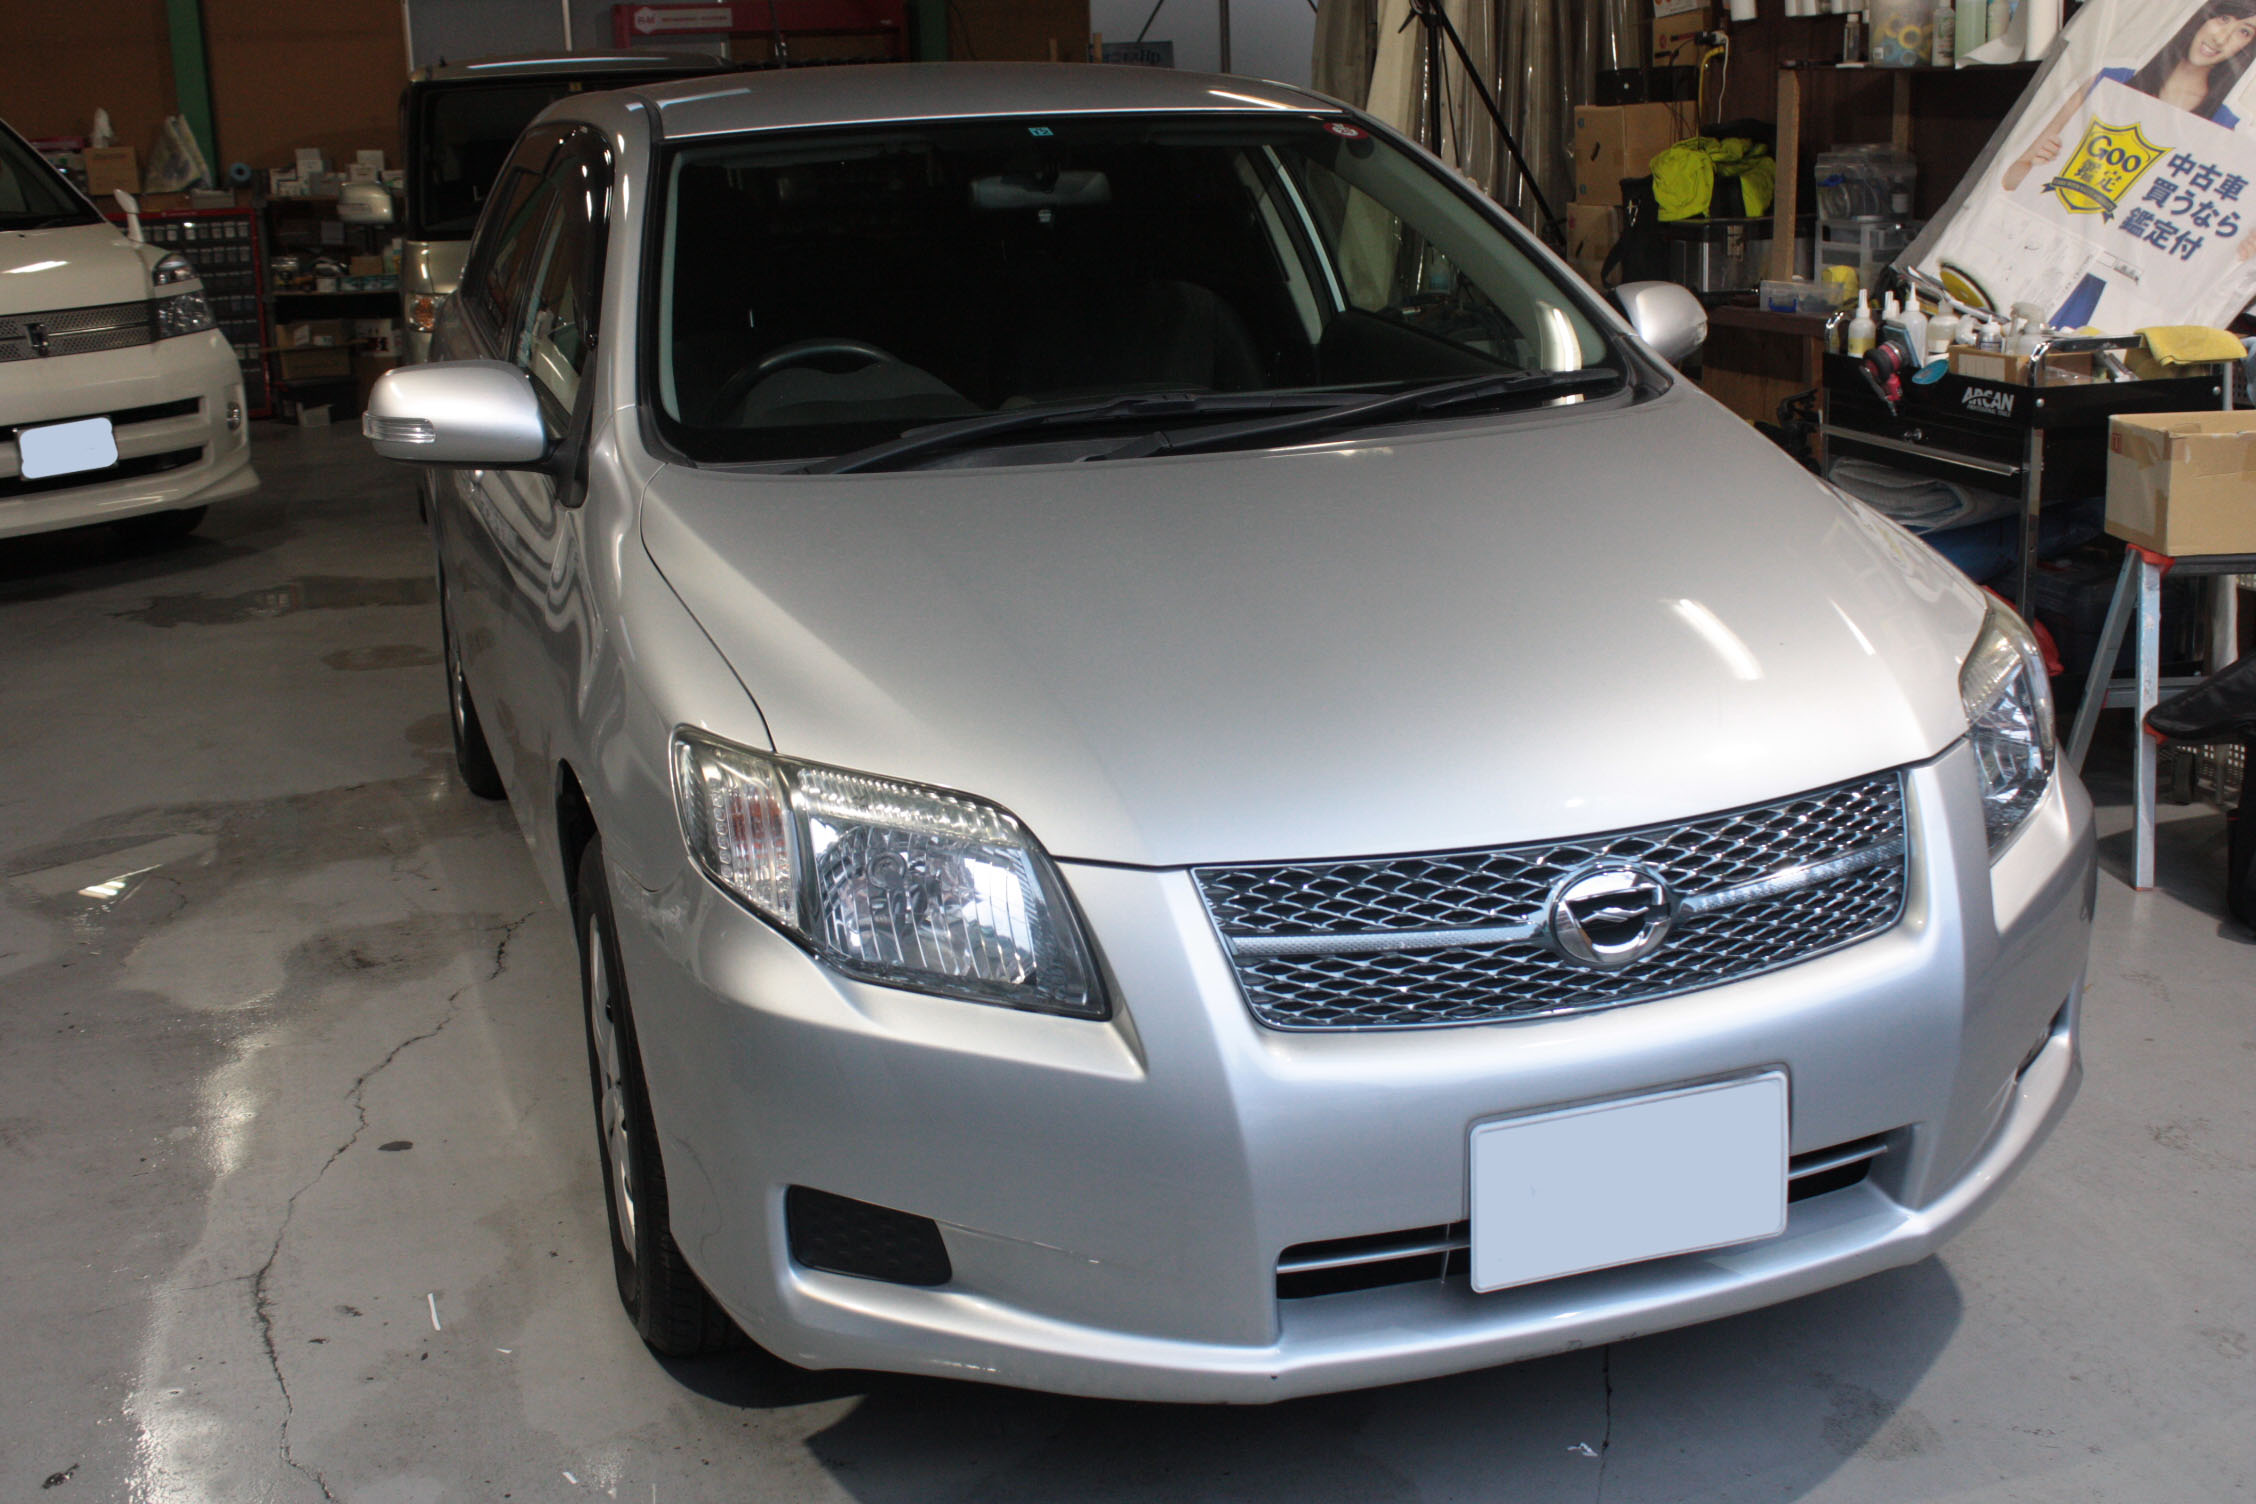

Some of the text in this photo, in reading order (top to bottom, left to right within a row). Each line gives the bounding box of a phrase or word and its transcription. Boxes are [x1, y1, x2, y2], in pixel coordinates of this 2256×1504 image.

[2087, 135, 2142, 173] Goo
[2167, 153, 2249, 201] 中古車
[2142, 177, 2242, 238] 買うなら
[2118, 207, 2205, 261] 鑑定付
[1961, 386, 2015, 412] ARCAN
